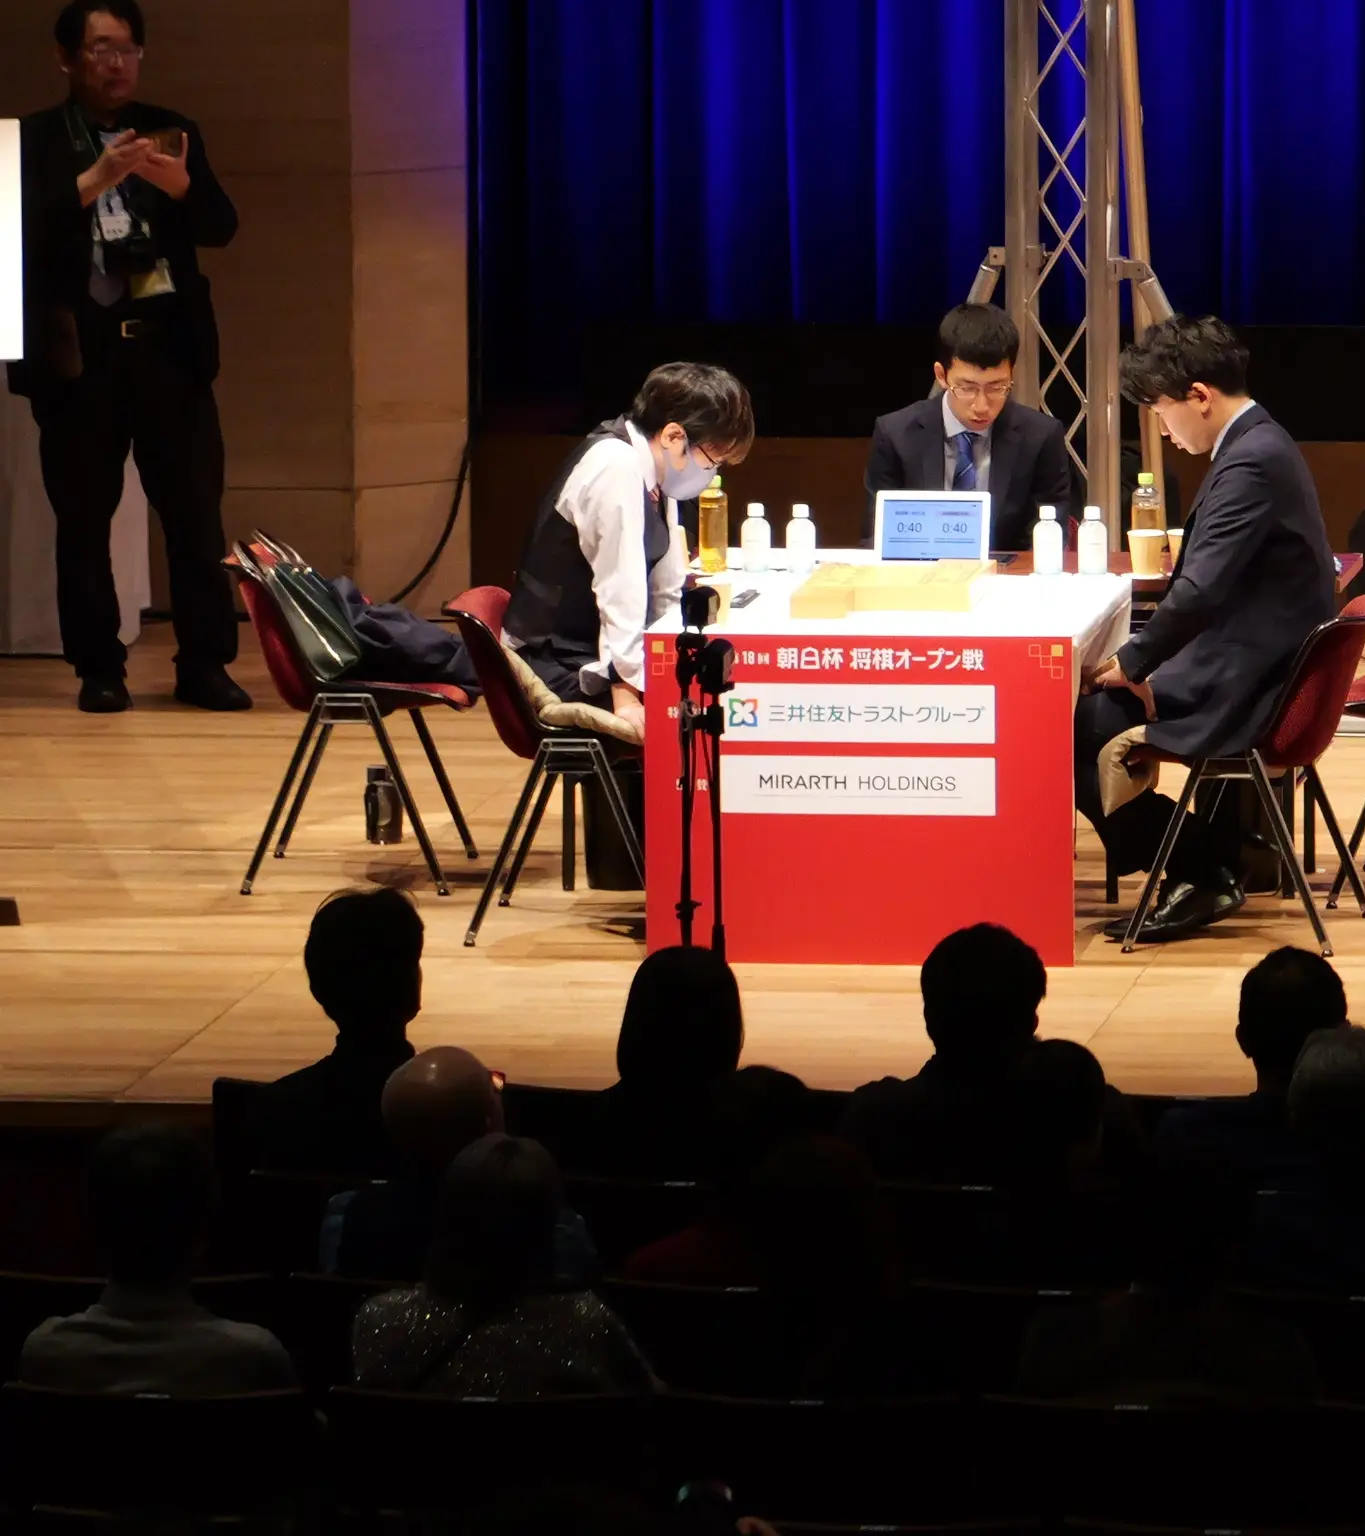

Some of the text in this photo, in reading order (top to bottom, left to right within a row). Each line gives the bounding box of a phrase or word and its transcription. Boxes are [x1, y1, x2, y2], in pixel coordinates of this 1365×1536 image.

[897, 522, 922, 532] 0:40
[943, 523, 967, 533] 0:40
[850, 648, 984, 670] 将棋オープン戦
[769, 704, 984, 722] 三井住友トラストグループ
[760, 775, 956, 791] MIRARTH HOLDINGS
